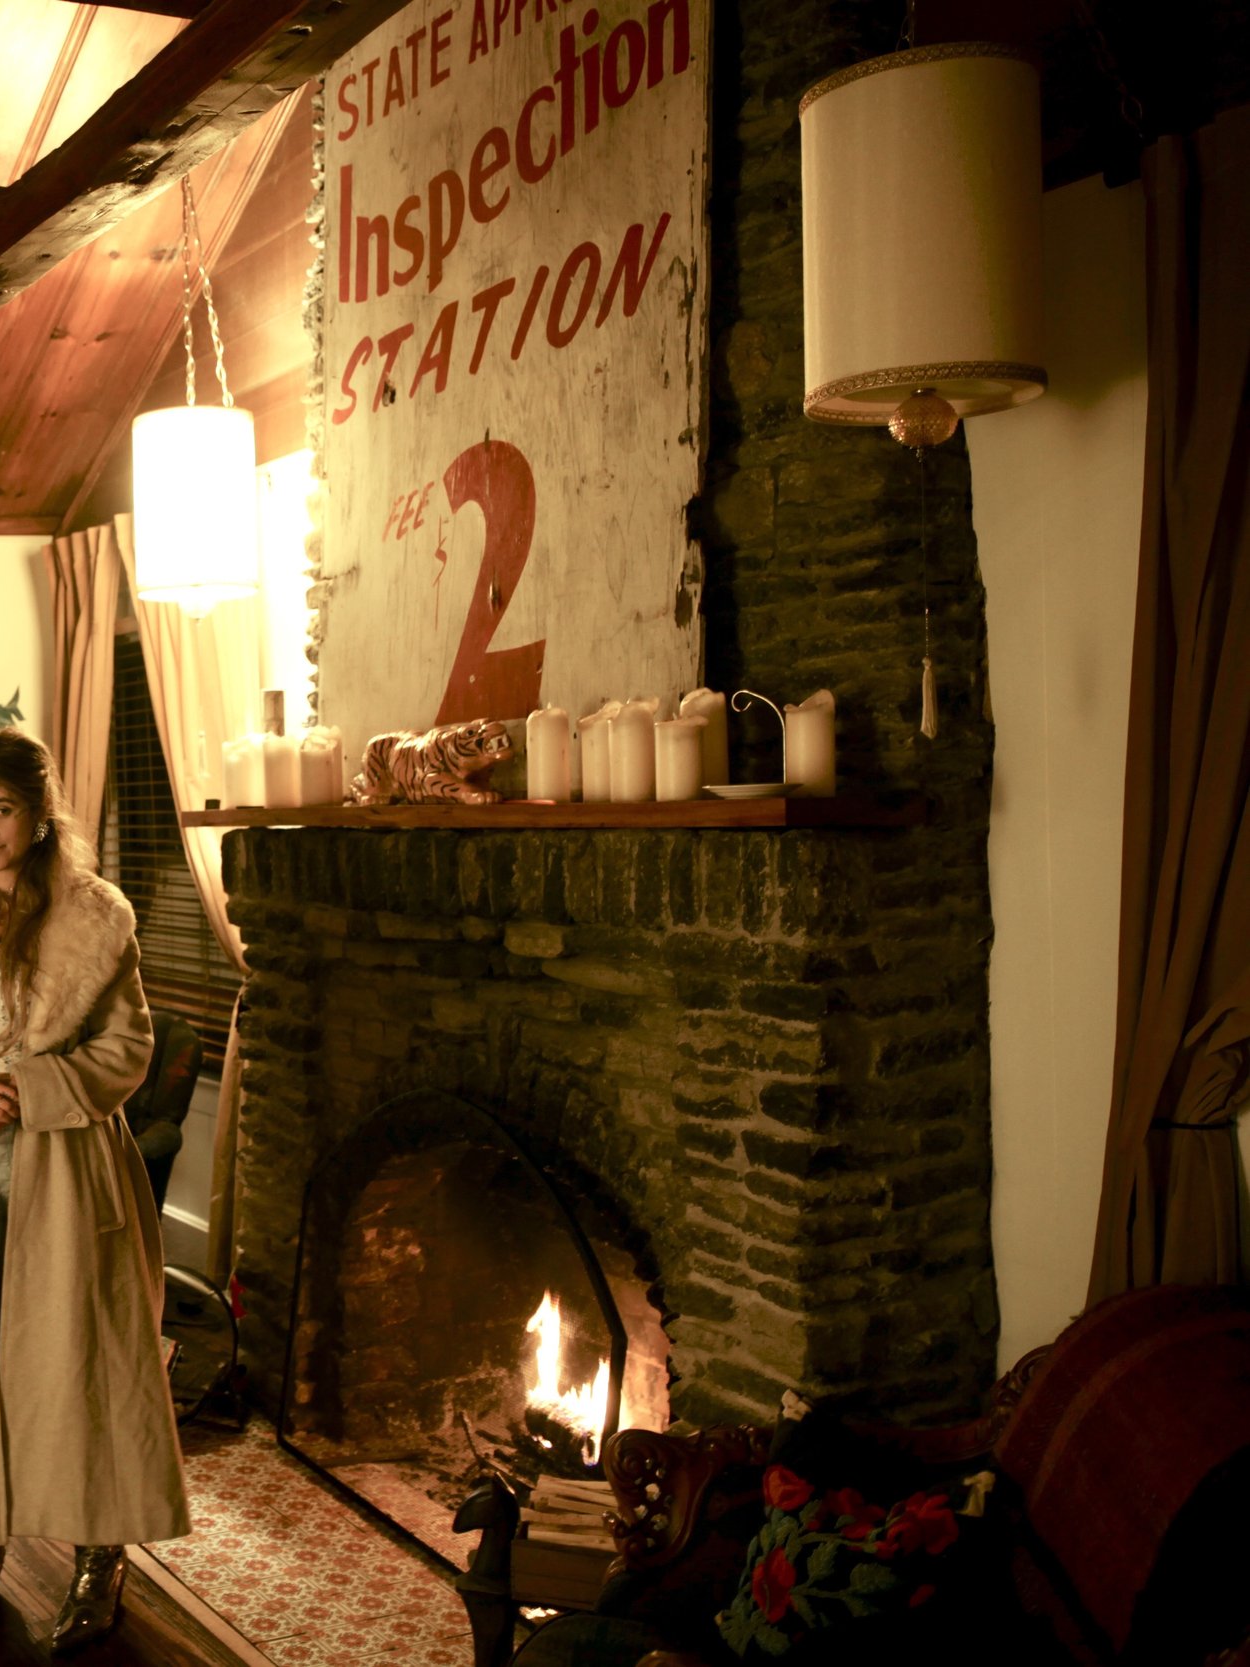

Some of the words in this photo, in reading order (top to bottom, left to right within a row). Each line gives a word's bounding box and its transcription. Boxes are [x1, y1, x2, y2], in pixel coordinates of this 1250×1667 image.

[337, 8, 454, 142] STATE
[337, 0, 690, 304] Inspection
[332, 212, 672, 425] STATION
[381, 481, 435, 543] FEE
